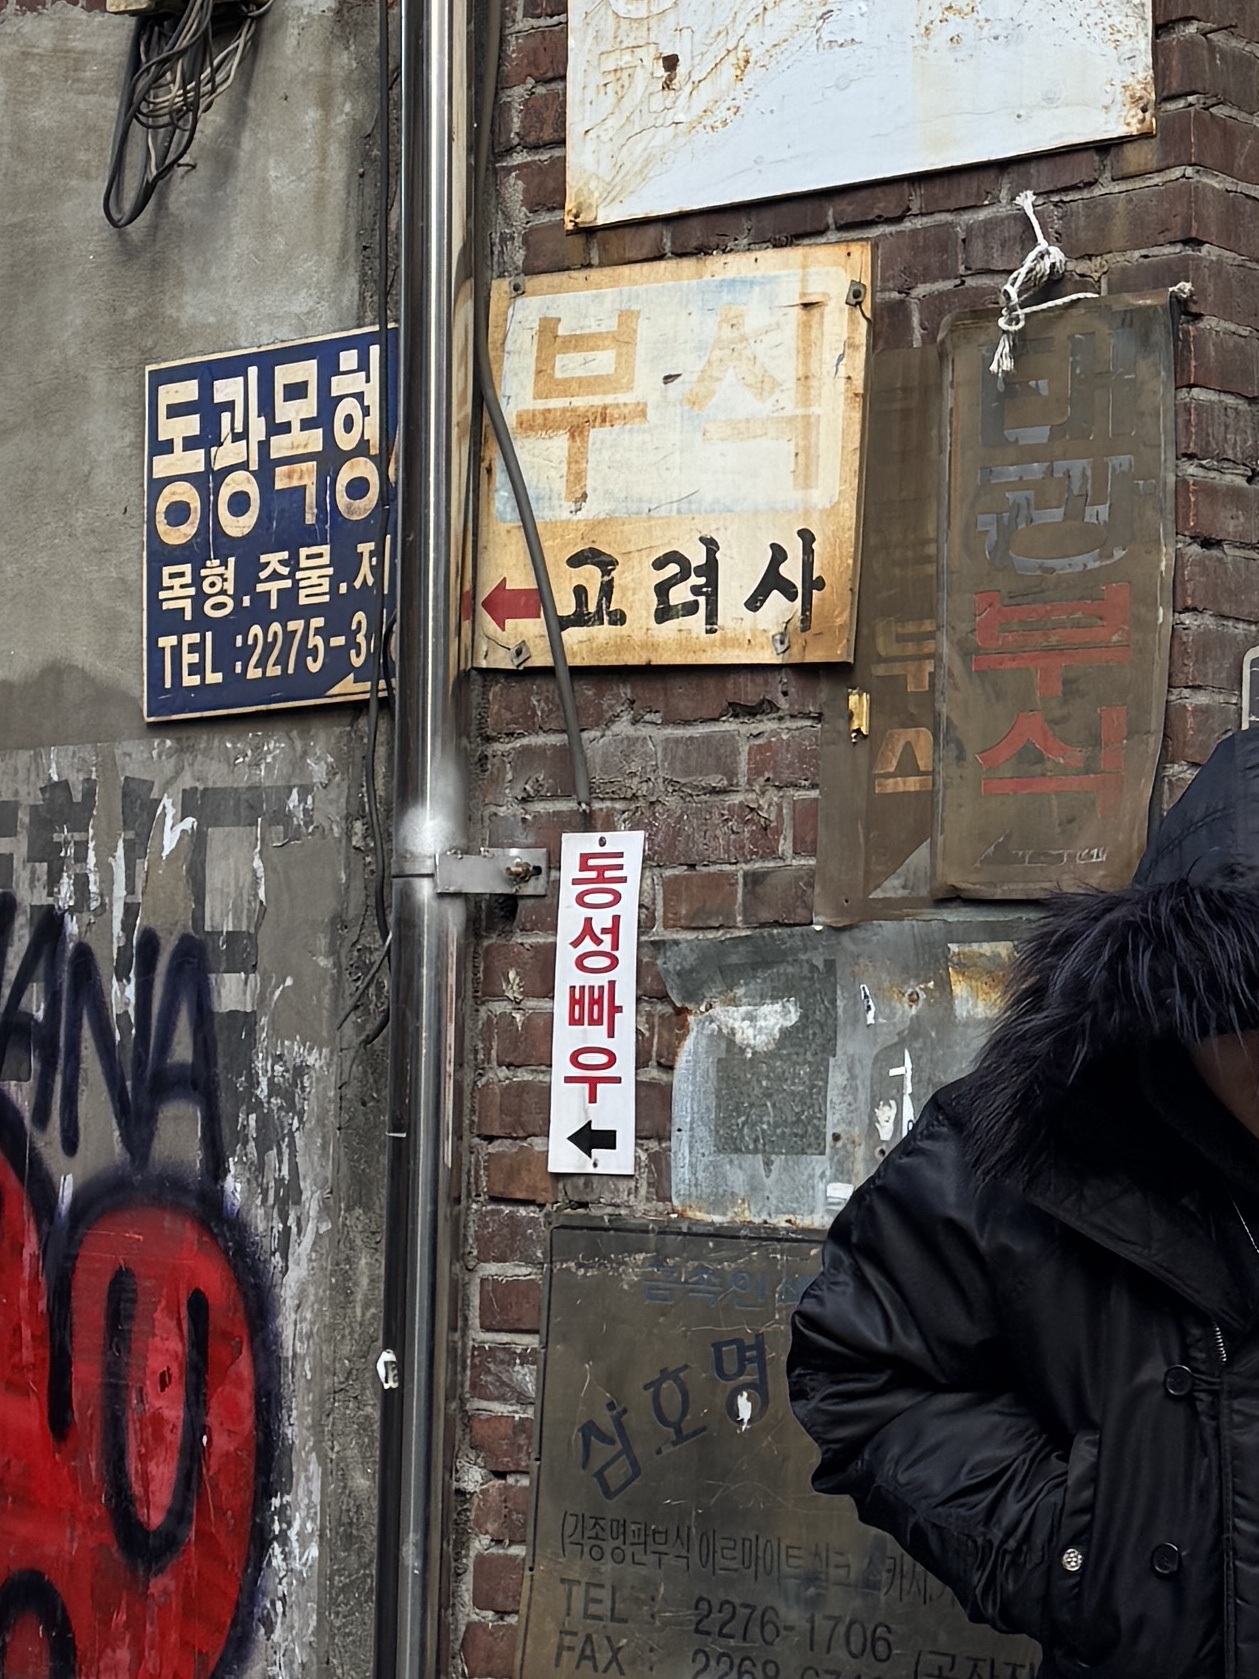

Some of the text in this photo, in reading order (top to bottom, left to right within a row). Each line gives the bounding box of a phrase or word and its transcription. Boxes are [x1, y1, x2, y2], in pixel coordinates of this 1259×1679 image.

[152, 344, 380, 545] 동광목형
[515, 293, 829, 503] 부식
[556, 528, 826, 634] 고려사
[563, 851, 628, 1104] 동성빠우
[693, 1594, 893, 1664] 2276-1706
